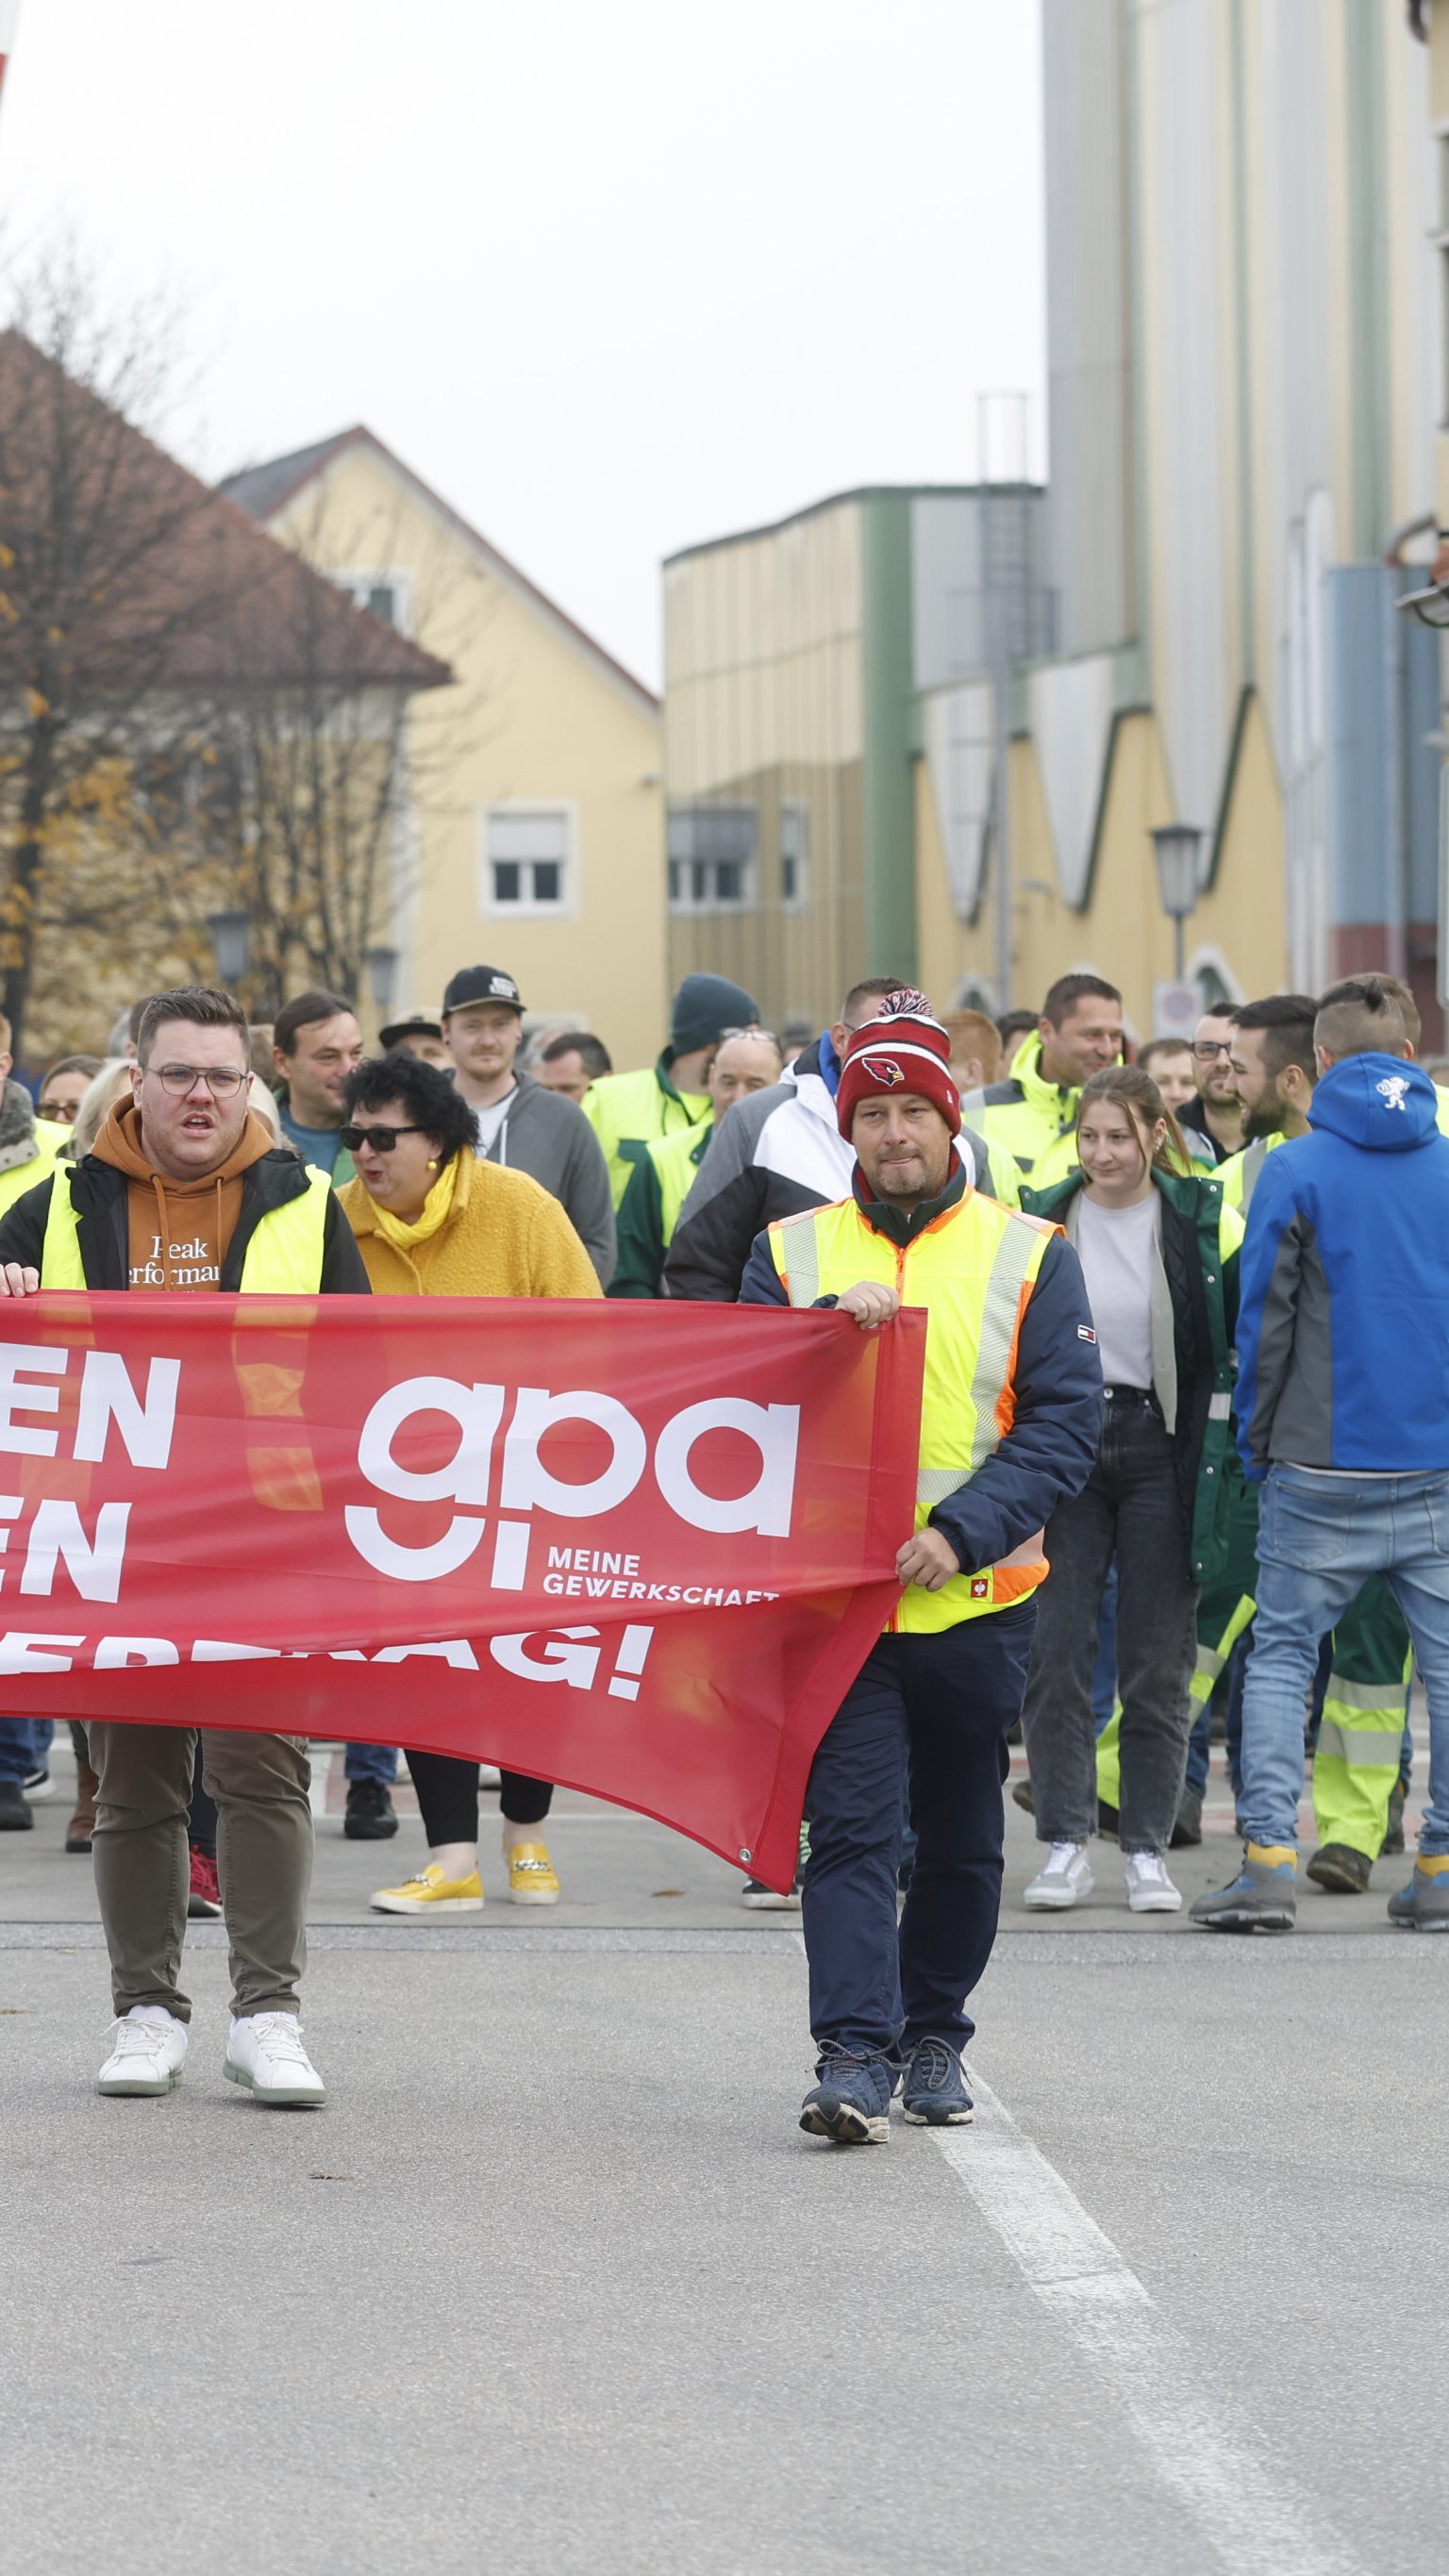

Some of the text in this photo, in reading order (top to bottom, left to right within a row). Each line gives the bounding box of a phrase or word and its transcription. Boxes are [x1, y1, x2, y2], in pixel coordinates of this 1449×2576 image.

[0, 1342, 181, 1470] EN
[344, 1376, 800, 1591] gpa
[547, 1546, 641, 1577] MEINE
